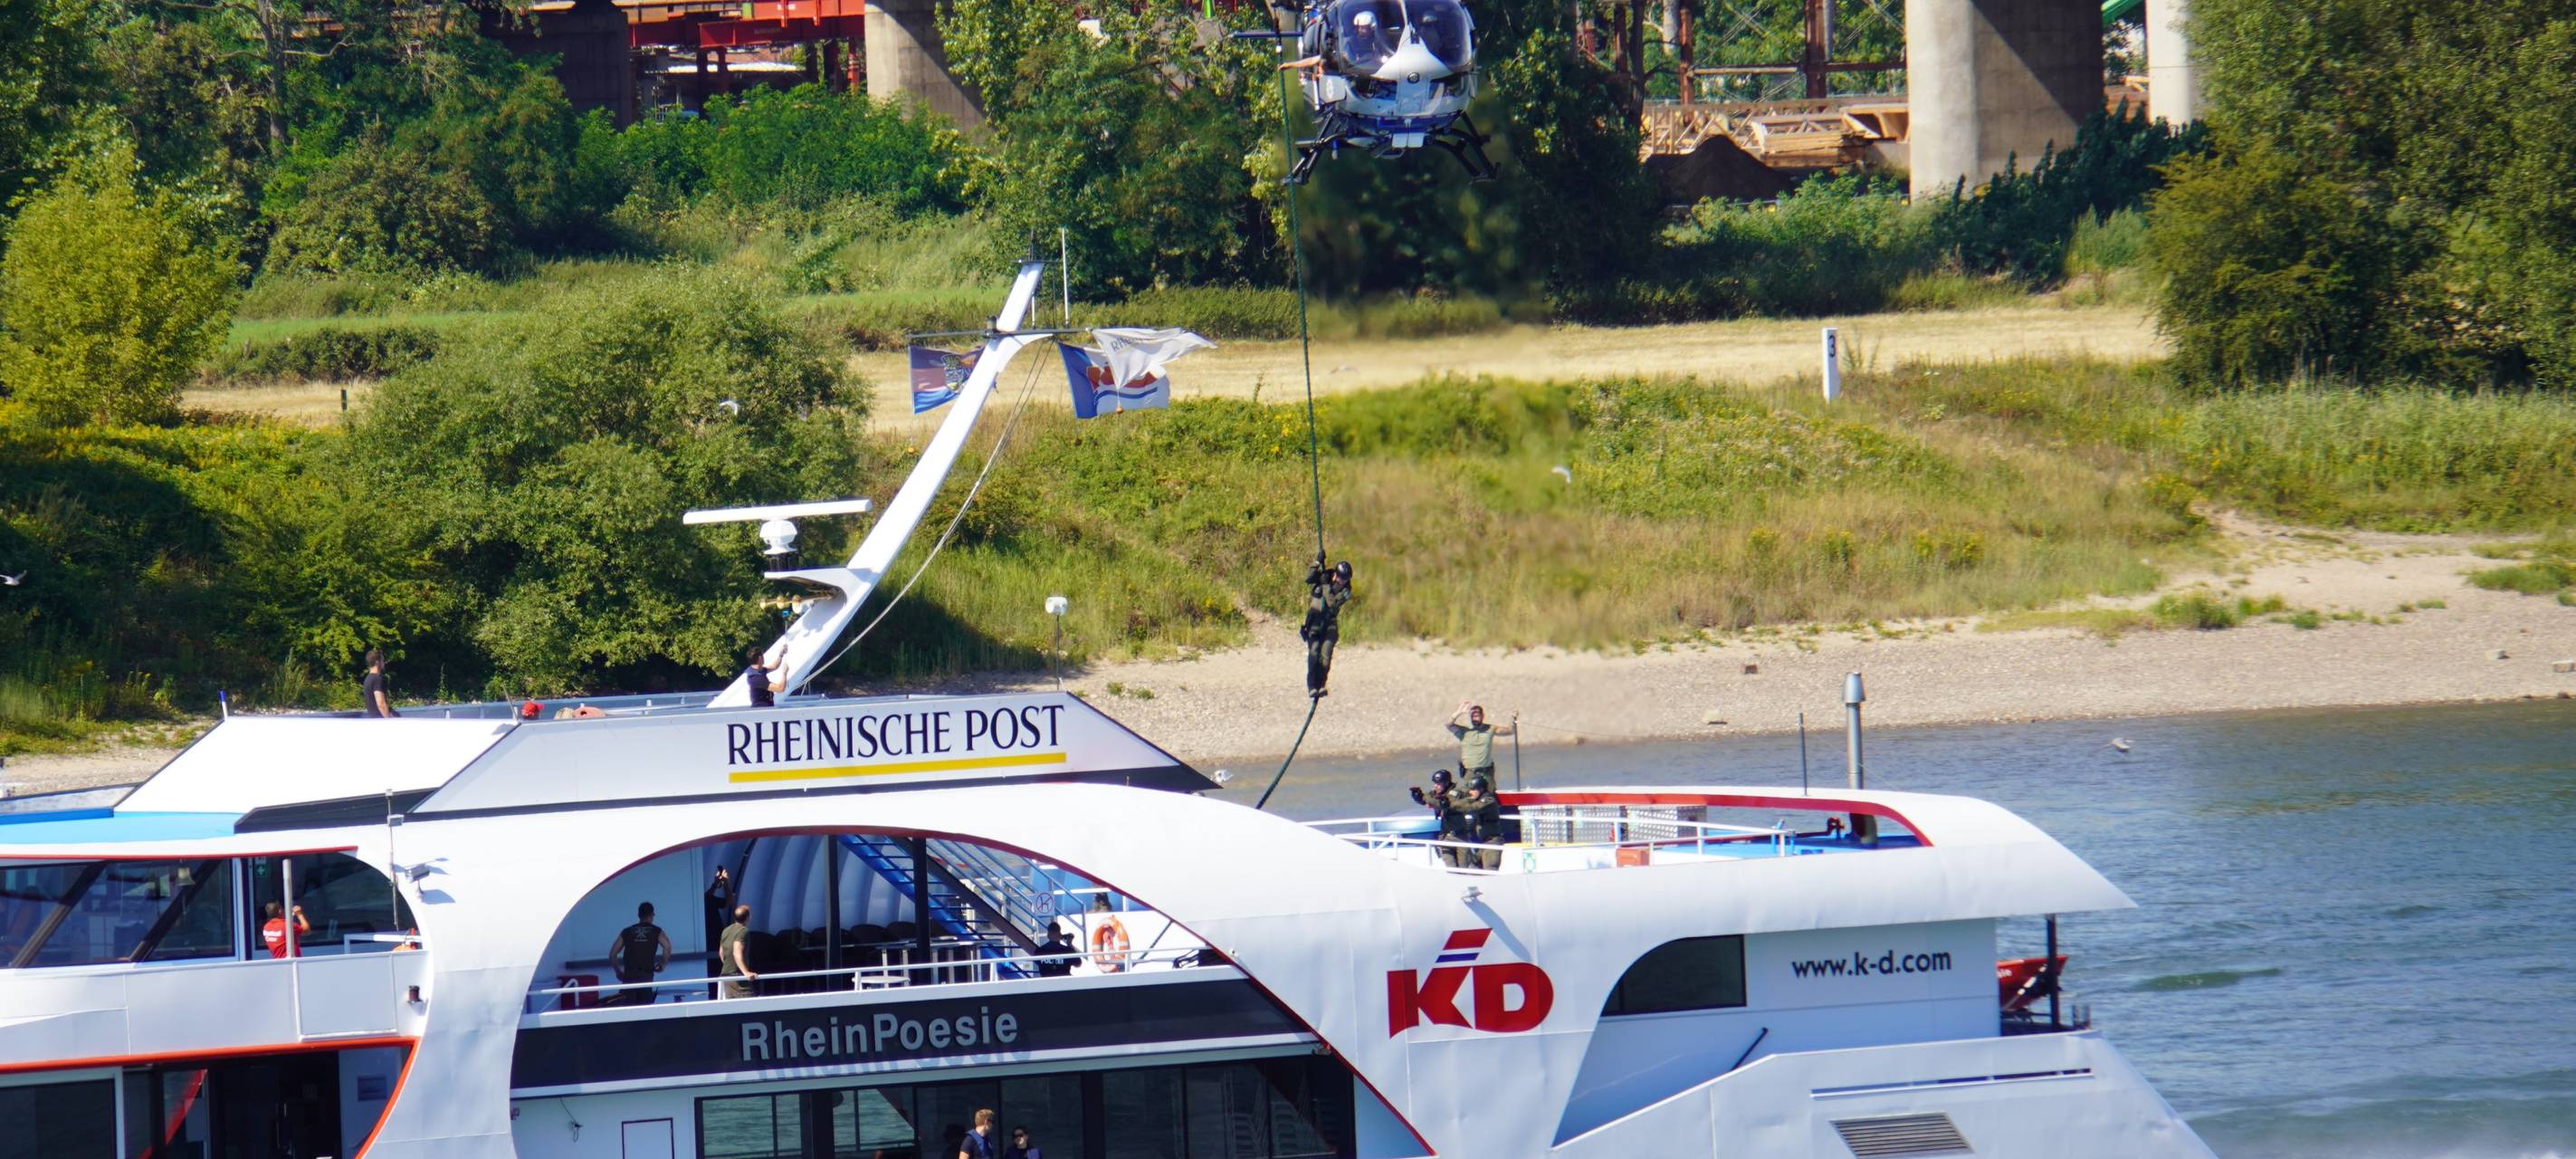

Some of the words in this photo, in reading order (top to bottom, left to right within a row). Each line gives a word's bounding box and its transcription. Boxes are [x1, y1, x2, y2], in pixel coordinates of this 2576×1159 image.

[1828, 334, 1837, 358] 3
[727, 711, 951, 765] RHEINISCHE
[965, 704, 1065, 752] POST
[1791, 950, 1952, 979] www.k-d.com
[1387, 962, 1554, 1039] KD
[740, 1006, 1018, 1062] RheinPoesie
